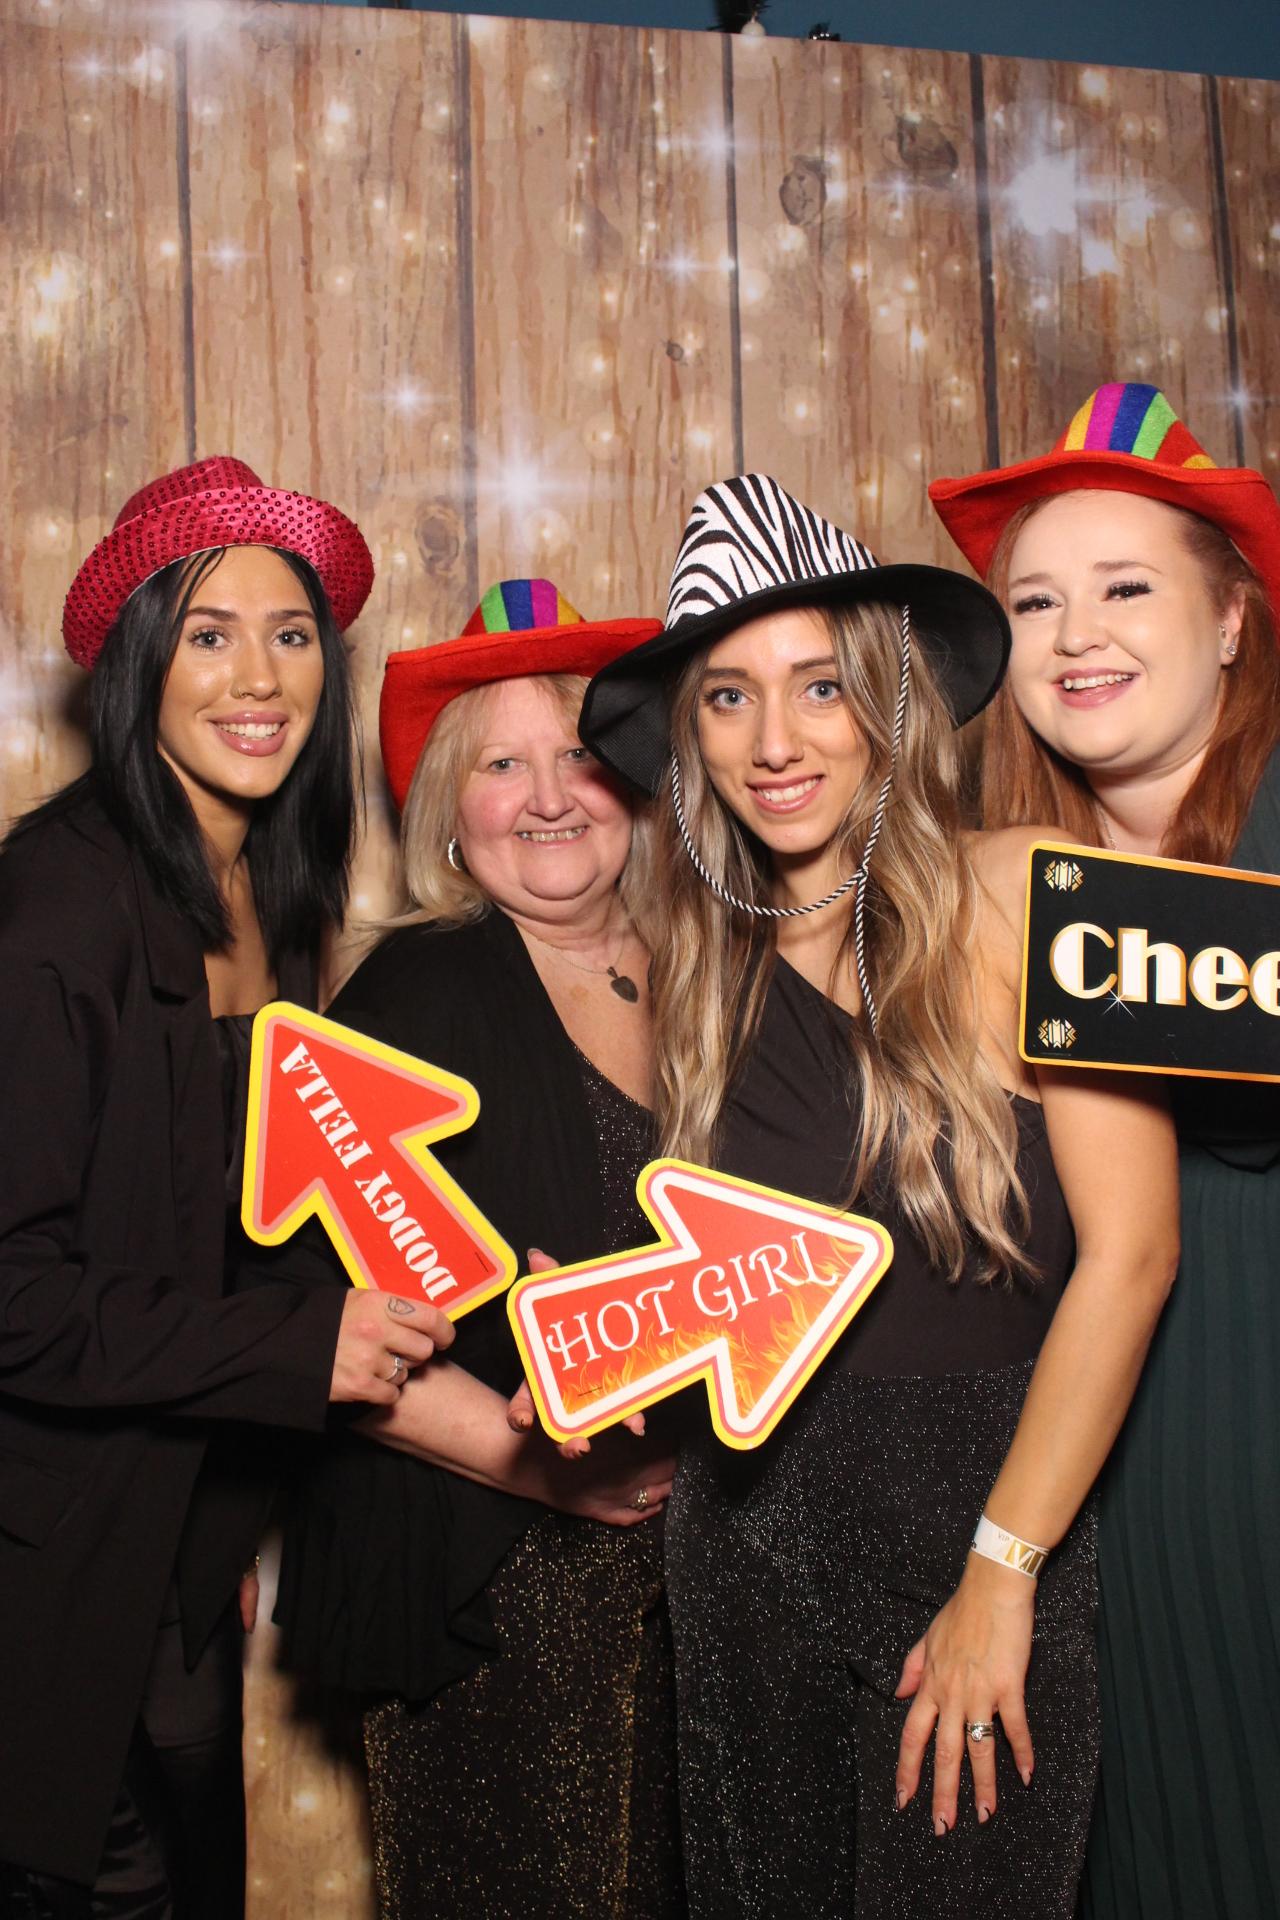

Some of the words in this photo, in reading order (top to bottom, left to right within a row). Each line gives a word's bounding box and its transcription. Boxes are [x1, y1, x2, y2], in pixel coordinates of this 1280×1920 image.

[280, 1042, 373, 1170] FELLA
[354, 1170, 458, 1301] DODGY
[546, 1280, 675, 1371] HOT
[692, 1232, 839, 1322] GIRL
